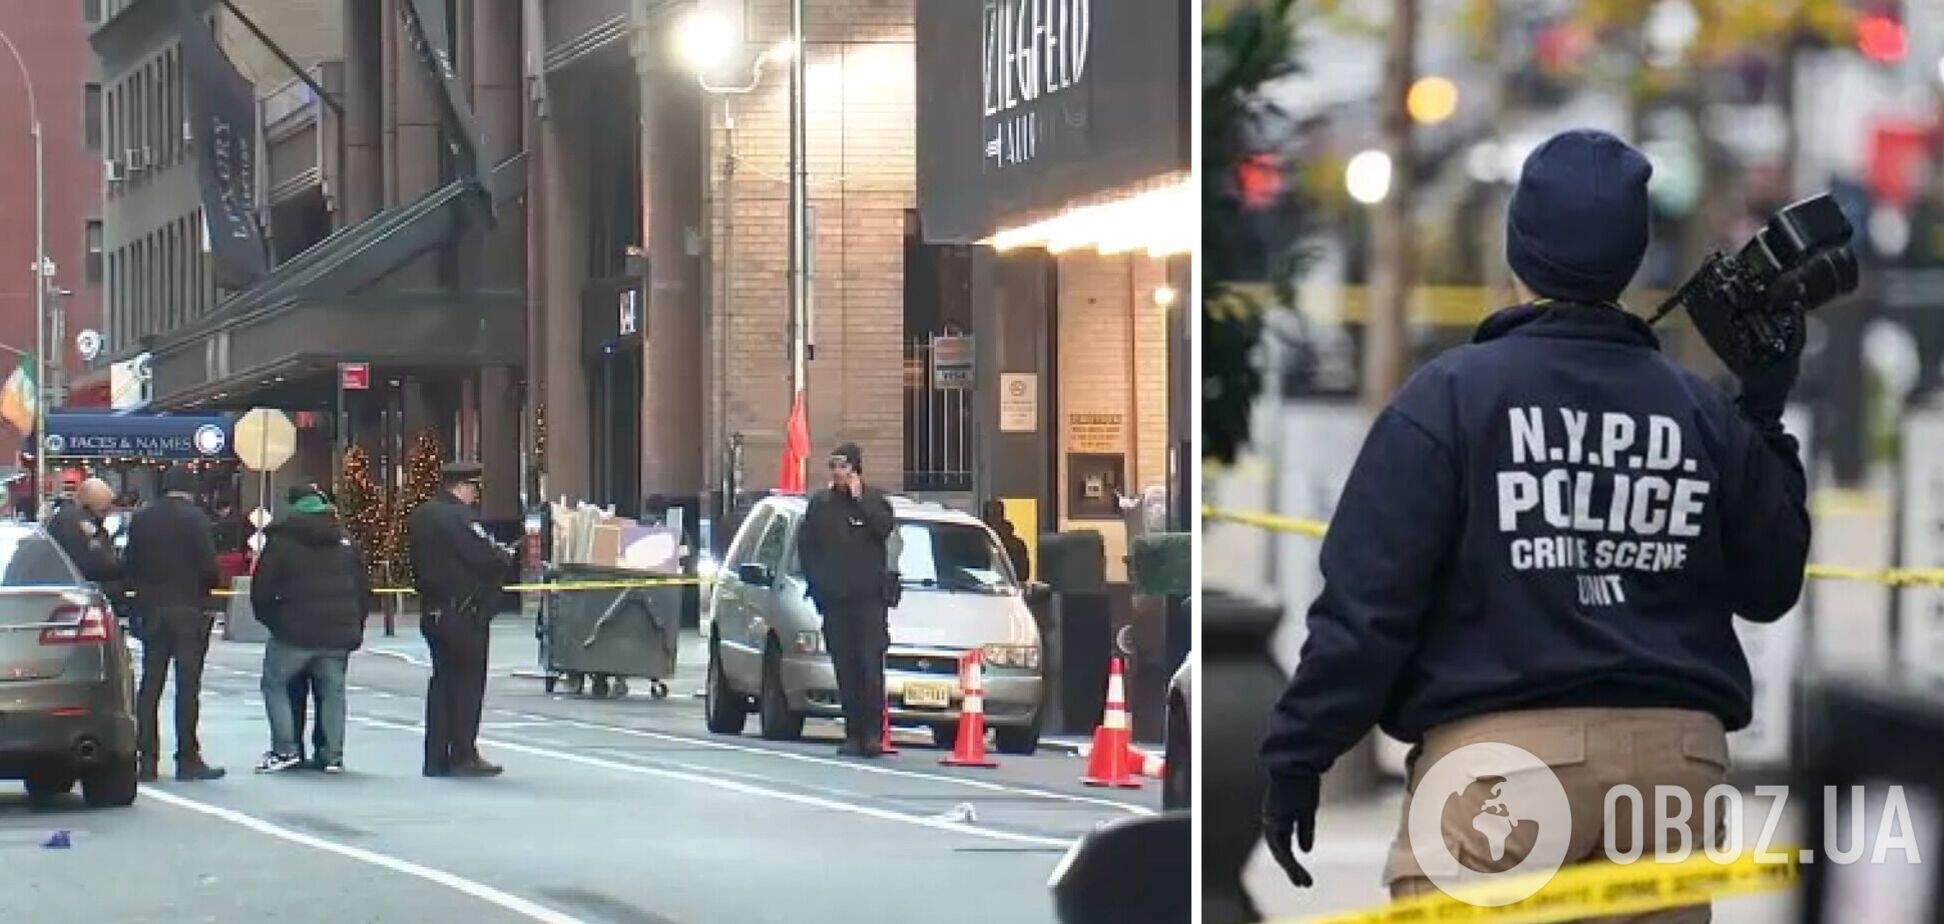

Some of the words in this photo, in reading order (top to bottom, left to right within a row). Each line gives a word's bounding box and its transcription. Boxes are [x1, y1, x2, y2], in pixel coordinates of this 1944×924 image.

[983, 0, 1089, 116] ZIEGFELD
[136, 437, 192, 449] NAMES
[1508, 406, 1697, 472] N.Y.P.D.
[1497, 468, 1711, 537] POLICE
[1595, 538, 1687, 572] SCENE
